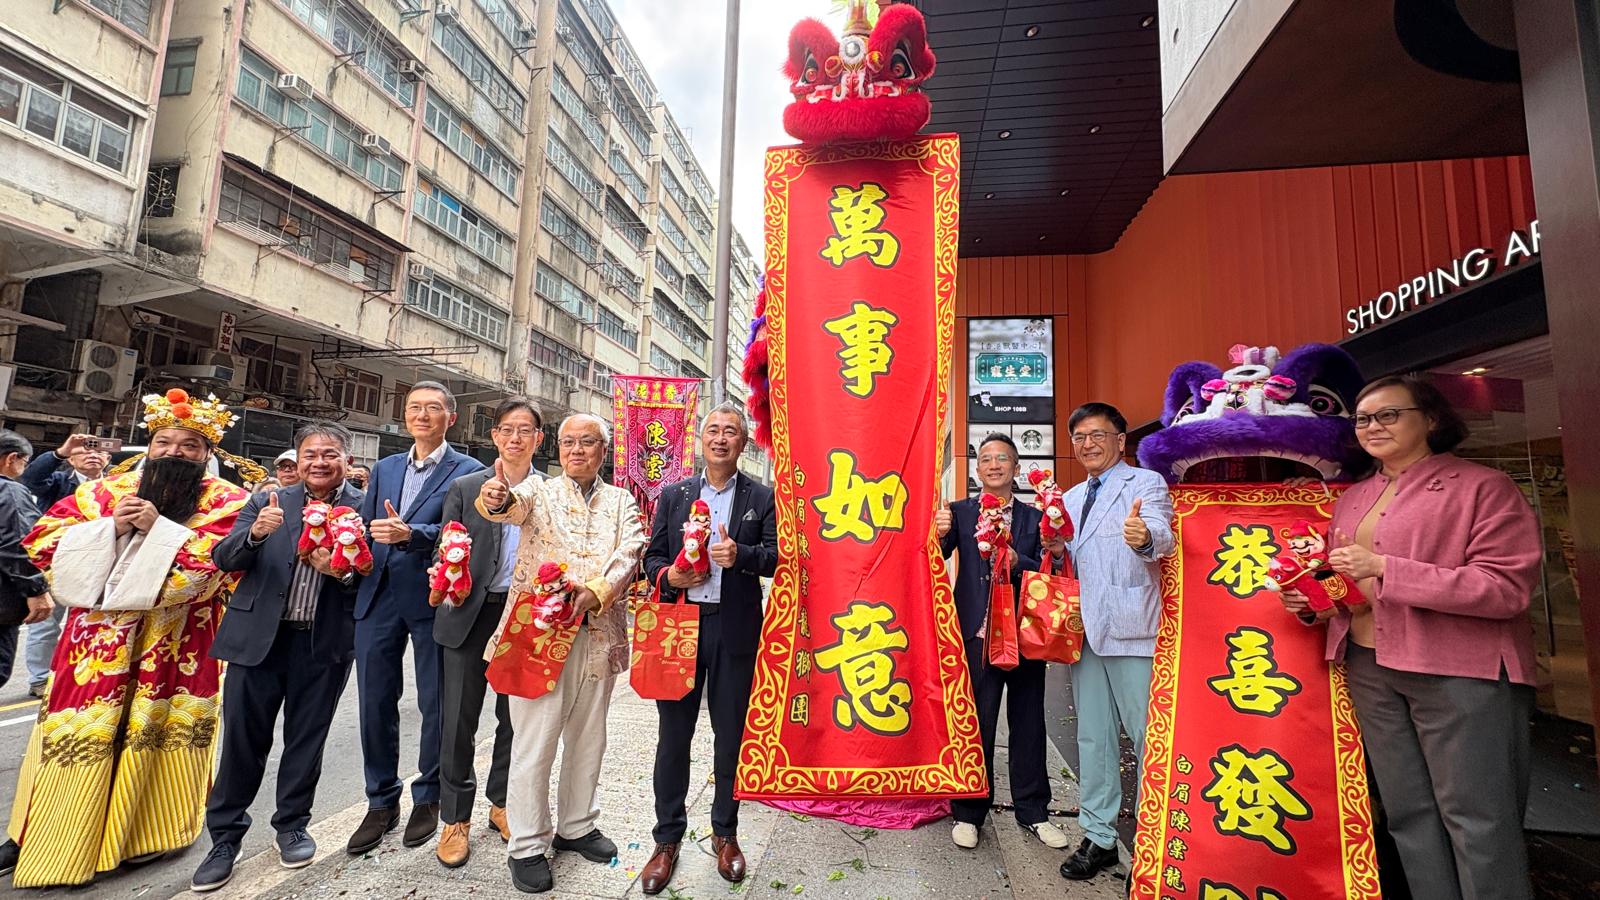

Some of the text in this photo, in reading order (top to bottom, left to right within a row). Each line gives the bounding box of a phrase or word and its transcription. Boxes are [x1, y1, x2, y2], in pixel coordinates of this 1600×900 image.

[1346, 248, 1490, 334] SHOPPING
[646, 420, 668, 480] 陳棠
[813, 182, 911, 736] 萬事如意
[1201, 523, 1313, 900] 恭喜發
[1161, 754, 1193, 900] 白眉陳棠龍
